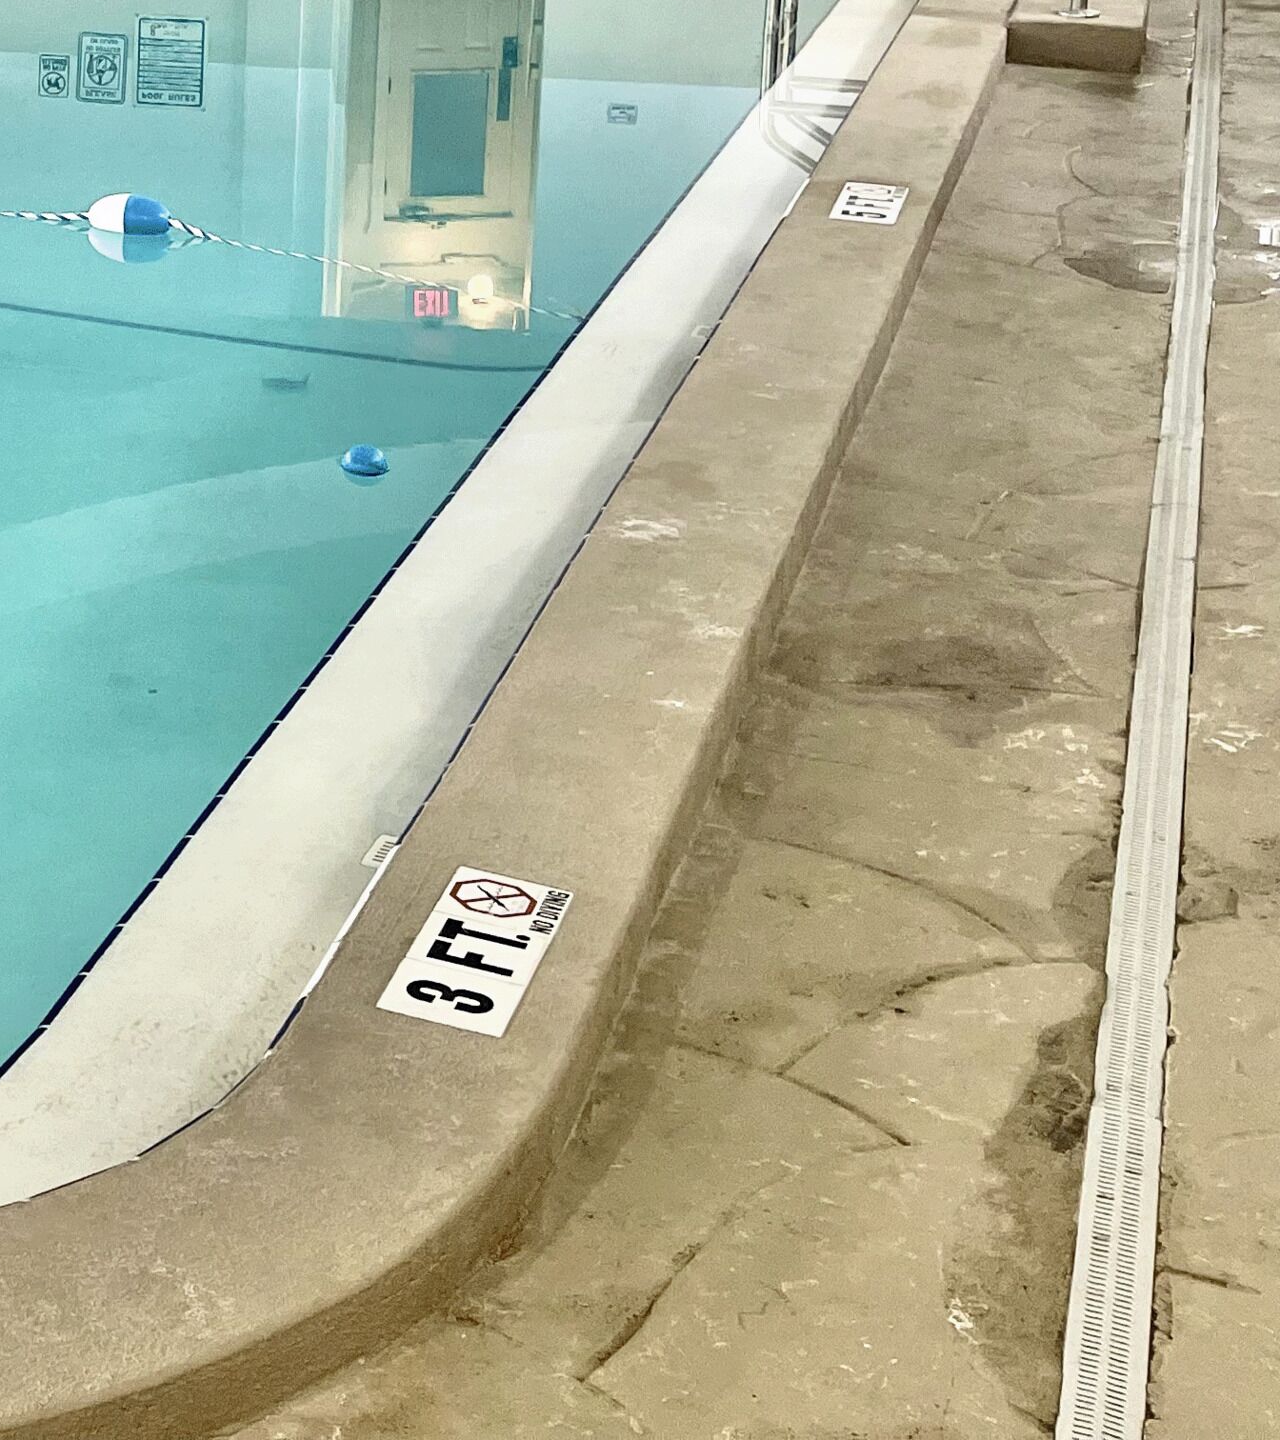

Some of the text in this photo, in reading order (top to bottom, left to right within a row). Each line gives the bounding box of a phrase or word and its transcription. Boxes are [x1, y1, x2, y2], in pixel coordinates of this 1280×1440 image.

[529, 890, 570, 935] NO DIVING
[406, 979, 494, 1014] 3
